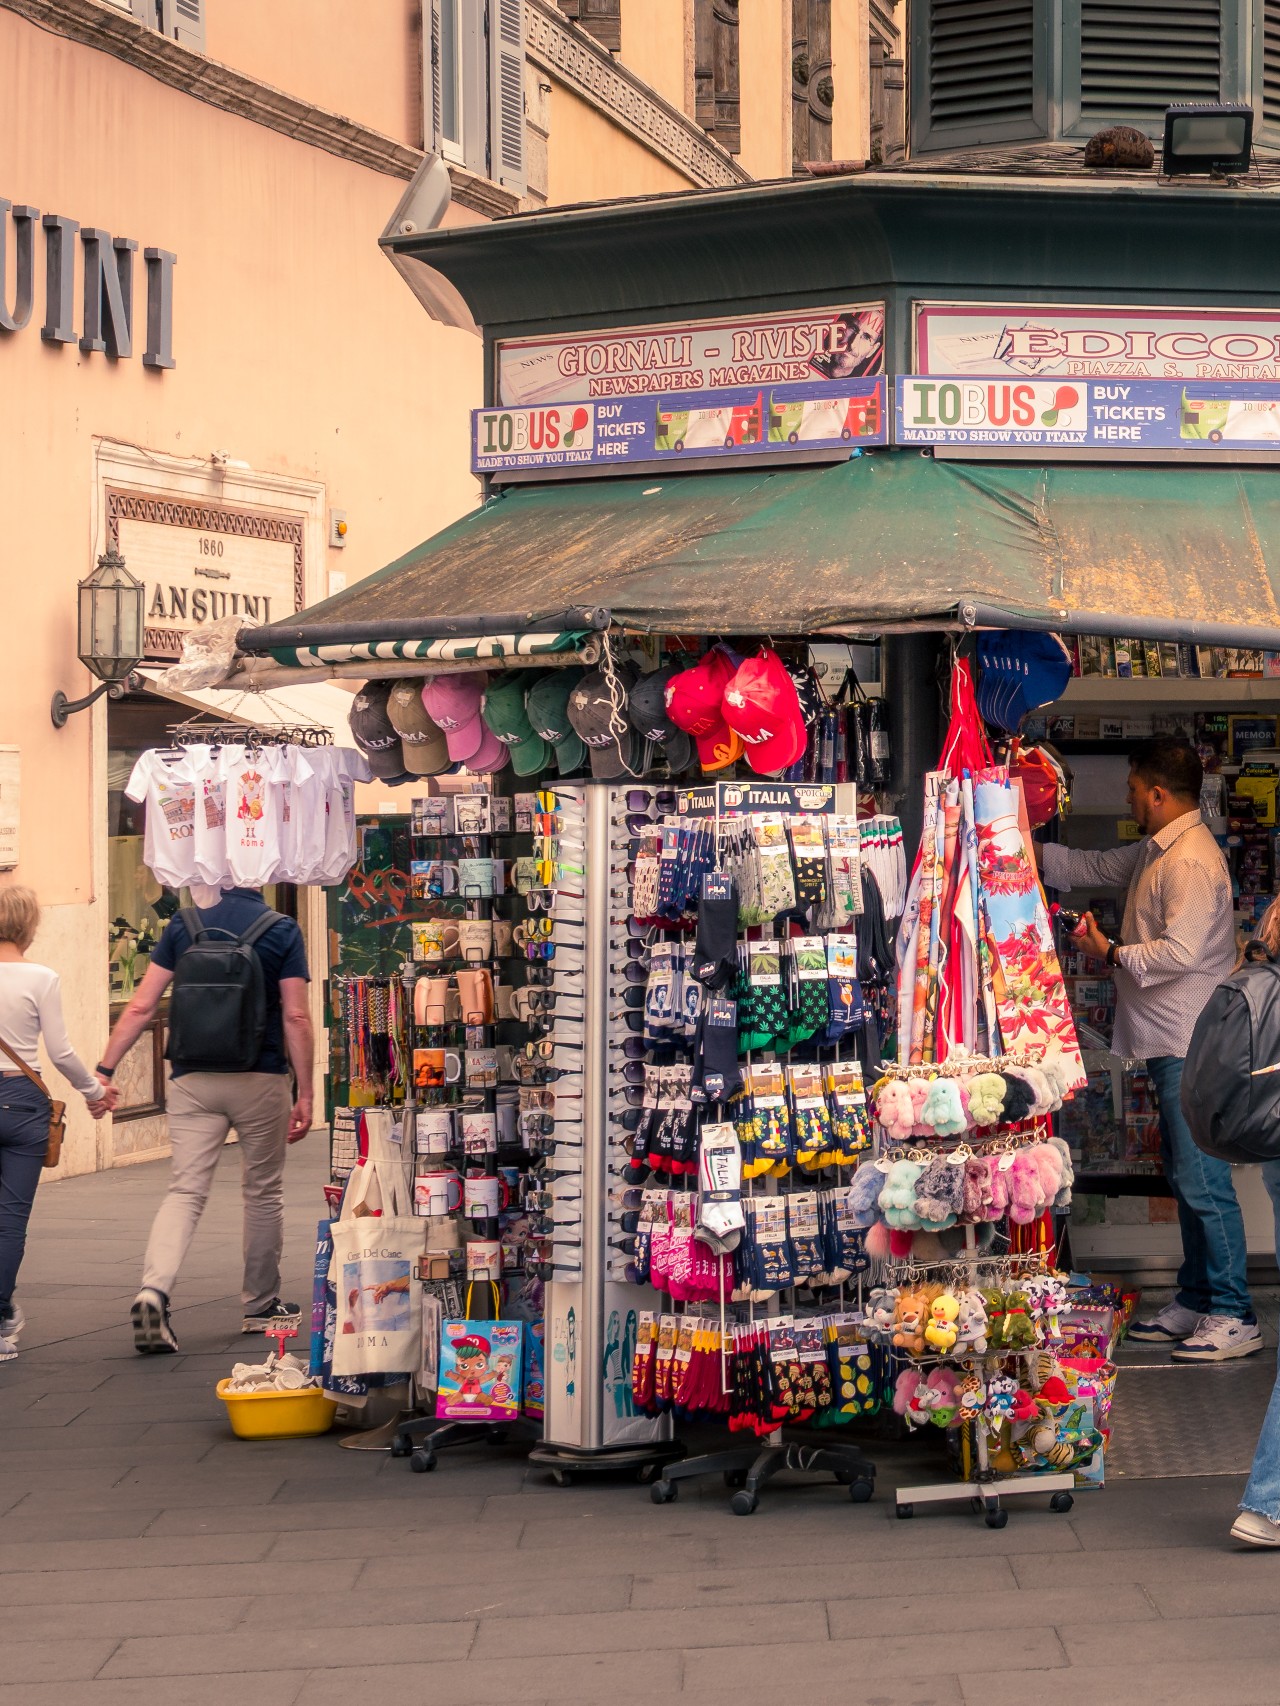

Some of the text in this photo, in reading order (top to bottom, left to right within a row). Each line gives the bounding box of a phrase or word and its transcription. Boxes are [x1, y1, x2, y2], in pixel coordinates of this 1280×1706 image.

[558, 335, 692, 377] GIORNALI
[732, 321, 848, 362] RIVISTE
[520, 353, 554, 368] NEWS
[1067, 361, 1151, 377] PIAZZA
[1164, 363, 1183, 378] S.
[588, 361, 810, 397] NEWSPAPERS MAGAZINES
[1094, 387, 1131, 400] BUY
[597, 405, 623, 418] BUY
[913, 383, 1035, 426] IOBUS
[1093, 406, 1166, 421] TICKETS
[483, 410, 560, 452] IOBUS
[597, 422, 646, 437] TICKETS
[904, 430, 1087, 443] MADE TO SHOW YOU ITALY
[1094, 426, 1142, 440] HERE
[597, 442, 629, 456] HERE
[477, 451, 593, 468] MADE TO SHOW YOU ITALY
[198, 537, 224, 557] 1860
[148, 583, 273, 623] ANSUINI
[1235, 731, 1277, 739] MEMORY
[691, 796, 716, 810] ITALIA
[749, 790, 791, 805] ITALIA
[241, 840, 265, 848] Roma
[708, 885, 726, 893] FILA
[699, 965, 715, 974] FILA
[714, 1011, 731, 1019] FILA
[705, 1078, 723, 1086] FILA
[363, 1248, 378, 1258] Del
